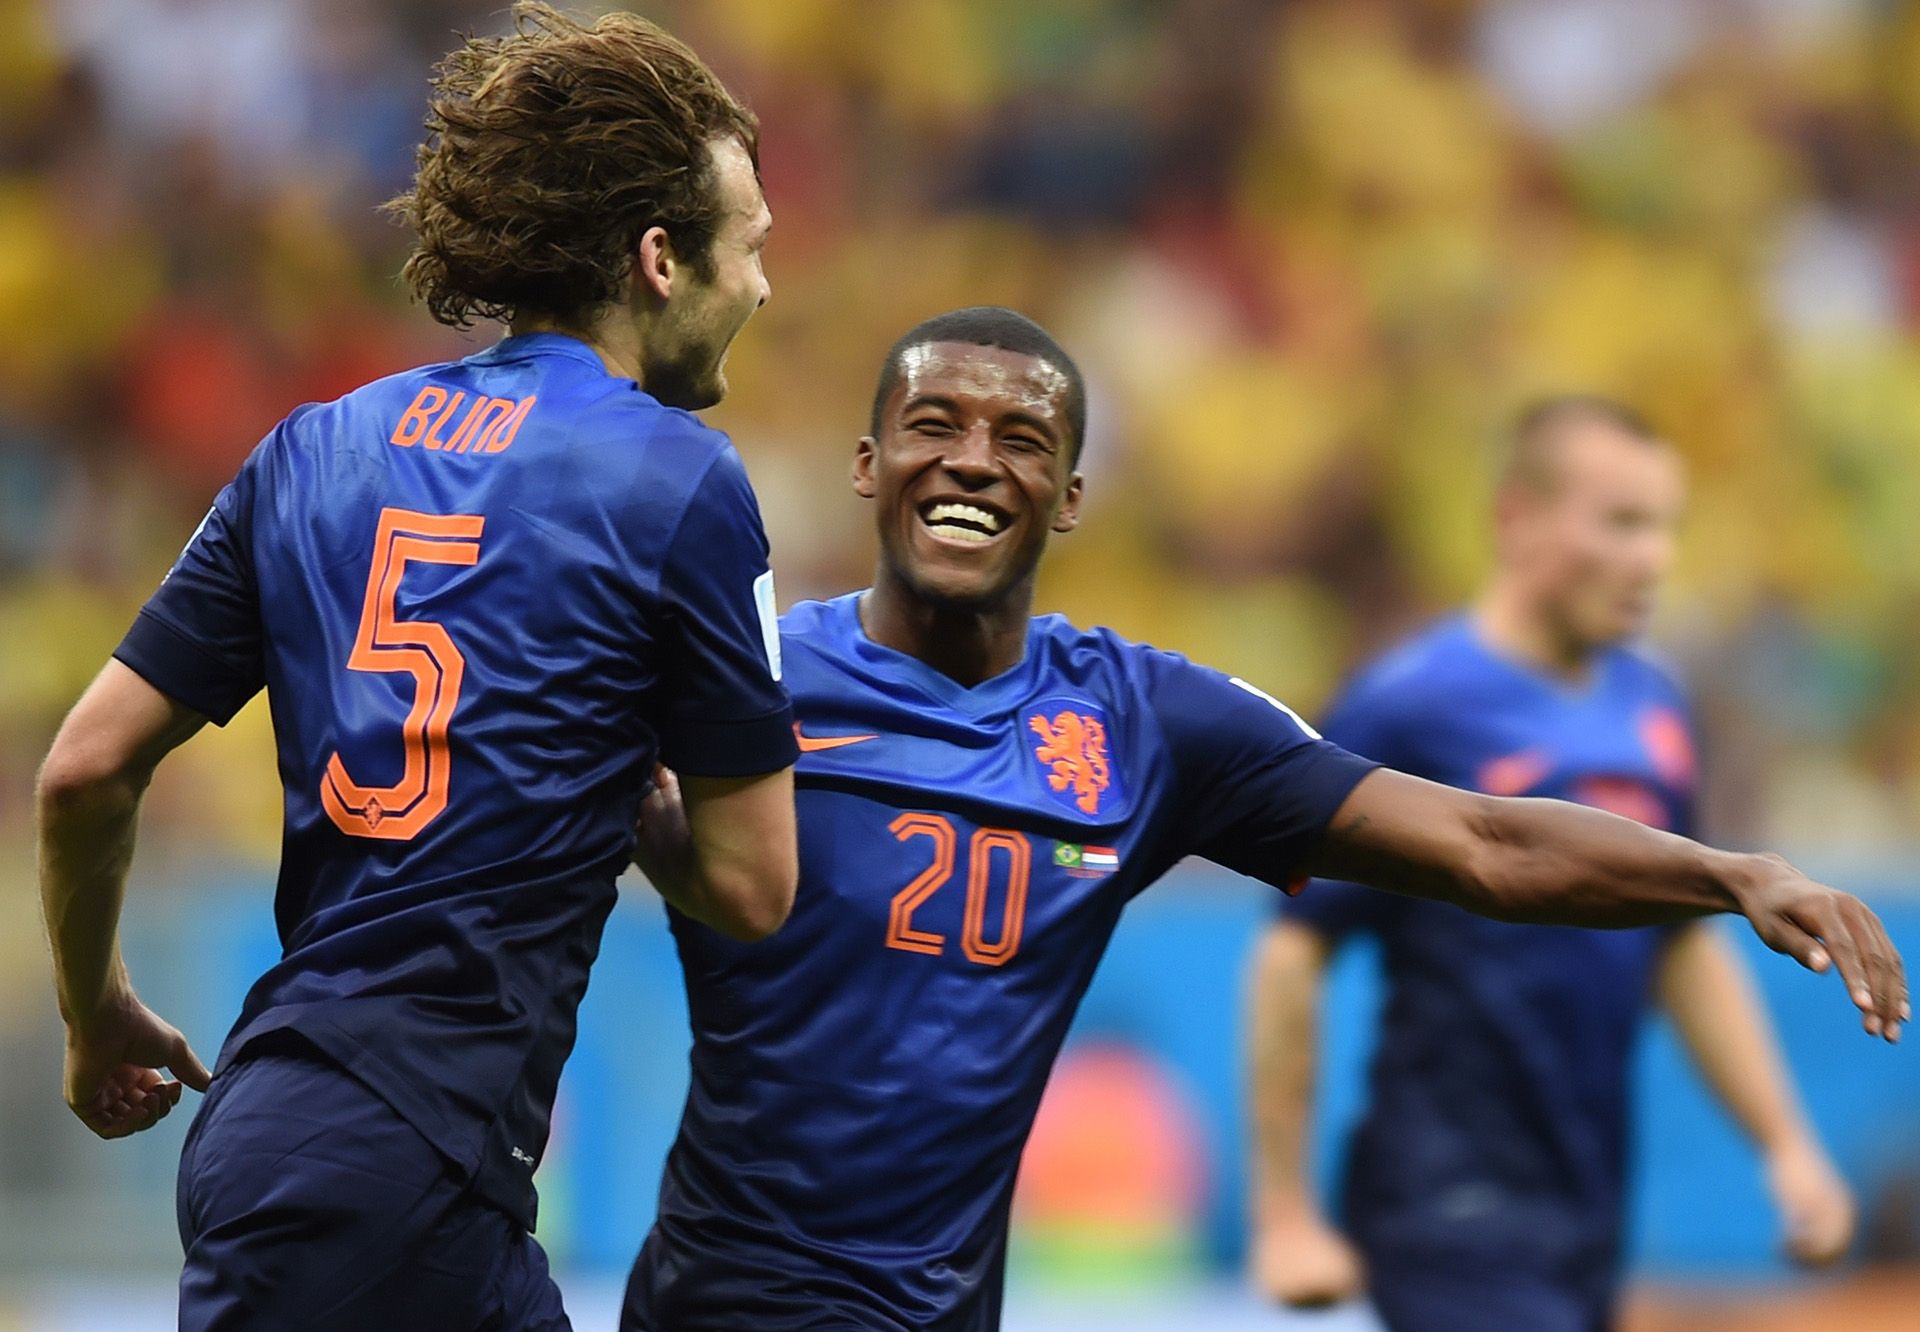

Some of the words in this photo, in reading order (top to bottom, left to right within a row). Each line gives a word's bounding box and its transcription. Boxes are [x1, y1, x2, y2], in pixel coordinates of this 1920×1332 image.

[390, 386, 537, 454] BLIND
[320, 507, 485, 840] 5
[885, 812, 1032, 966] 20
